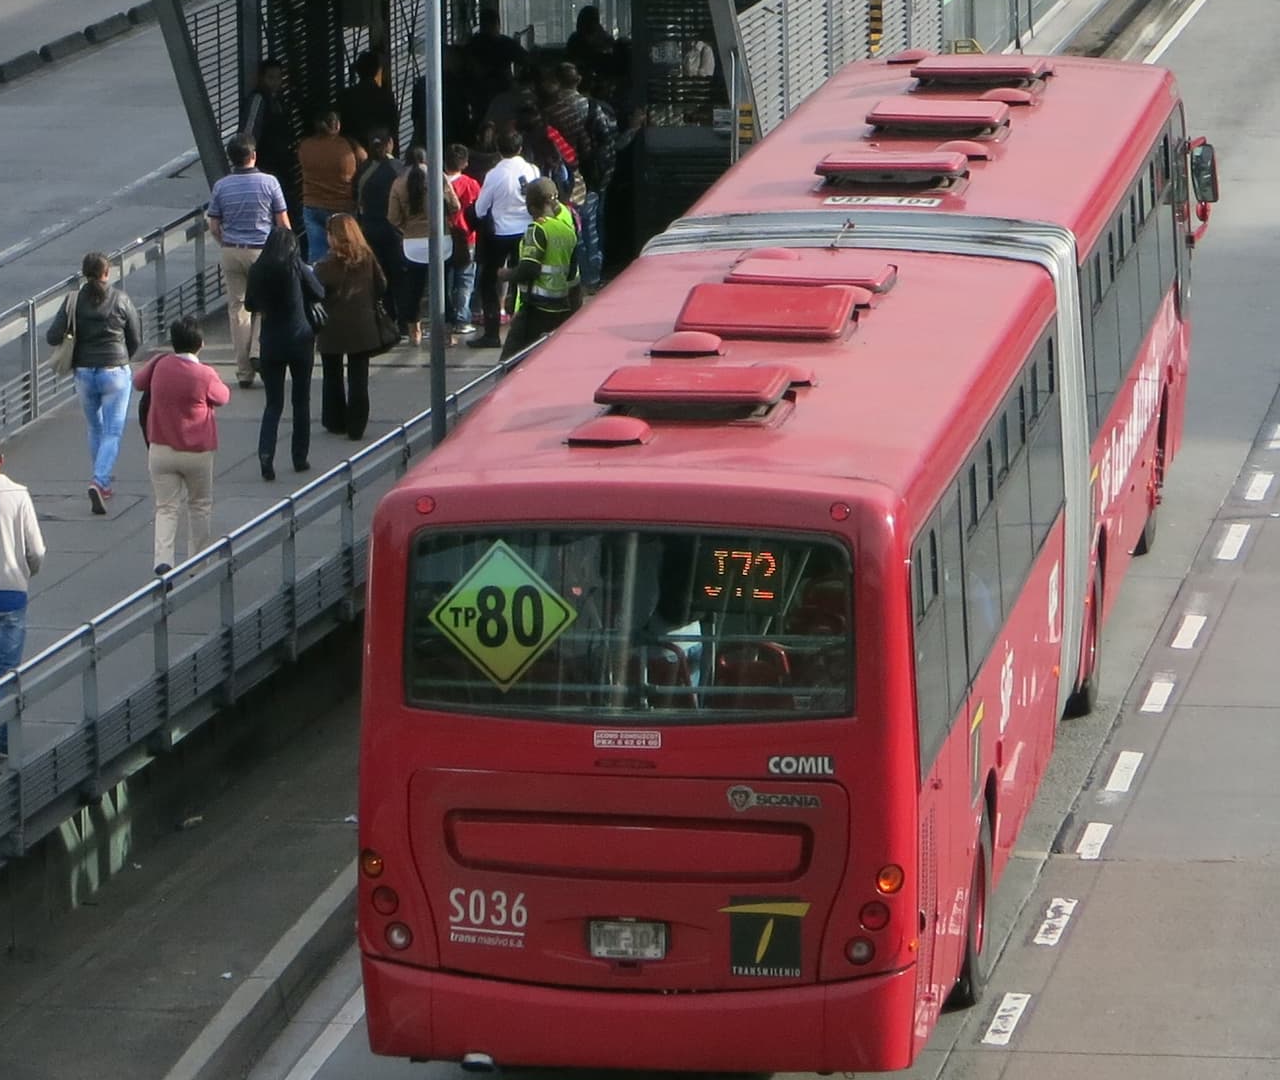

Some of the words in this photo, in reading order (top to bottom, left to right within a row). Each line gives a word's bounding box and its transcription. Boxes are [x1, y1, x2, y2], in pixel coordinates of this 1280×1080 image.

[448, 606, 476, 628] TP
[476, 585, 544, 649] 80
[768, 756, 834, 774] COMIL
[755, 793, 821, 807] SCANIA
[448, 887, 528, 927] S036
[732, 965, 801, 977] TRANSMILENIO
